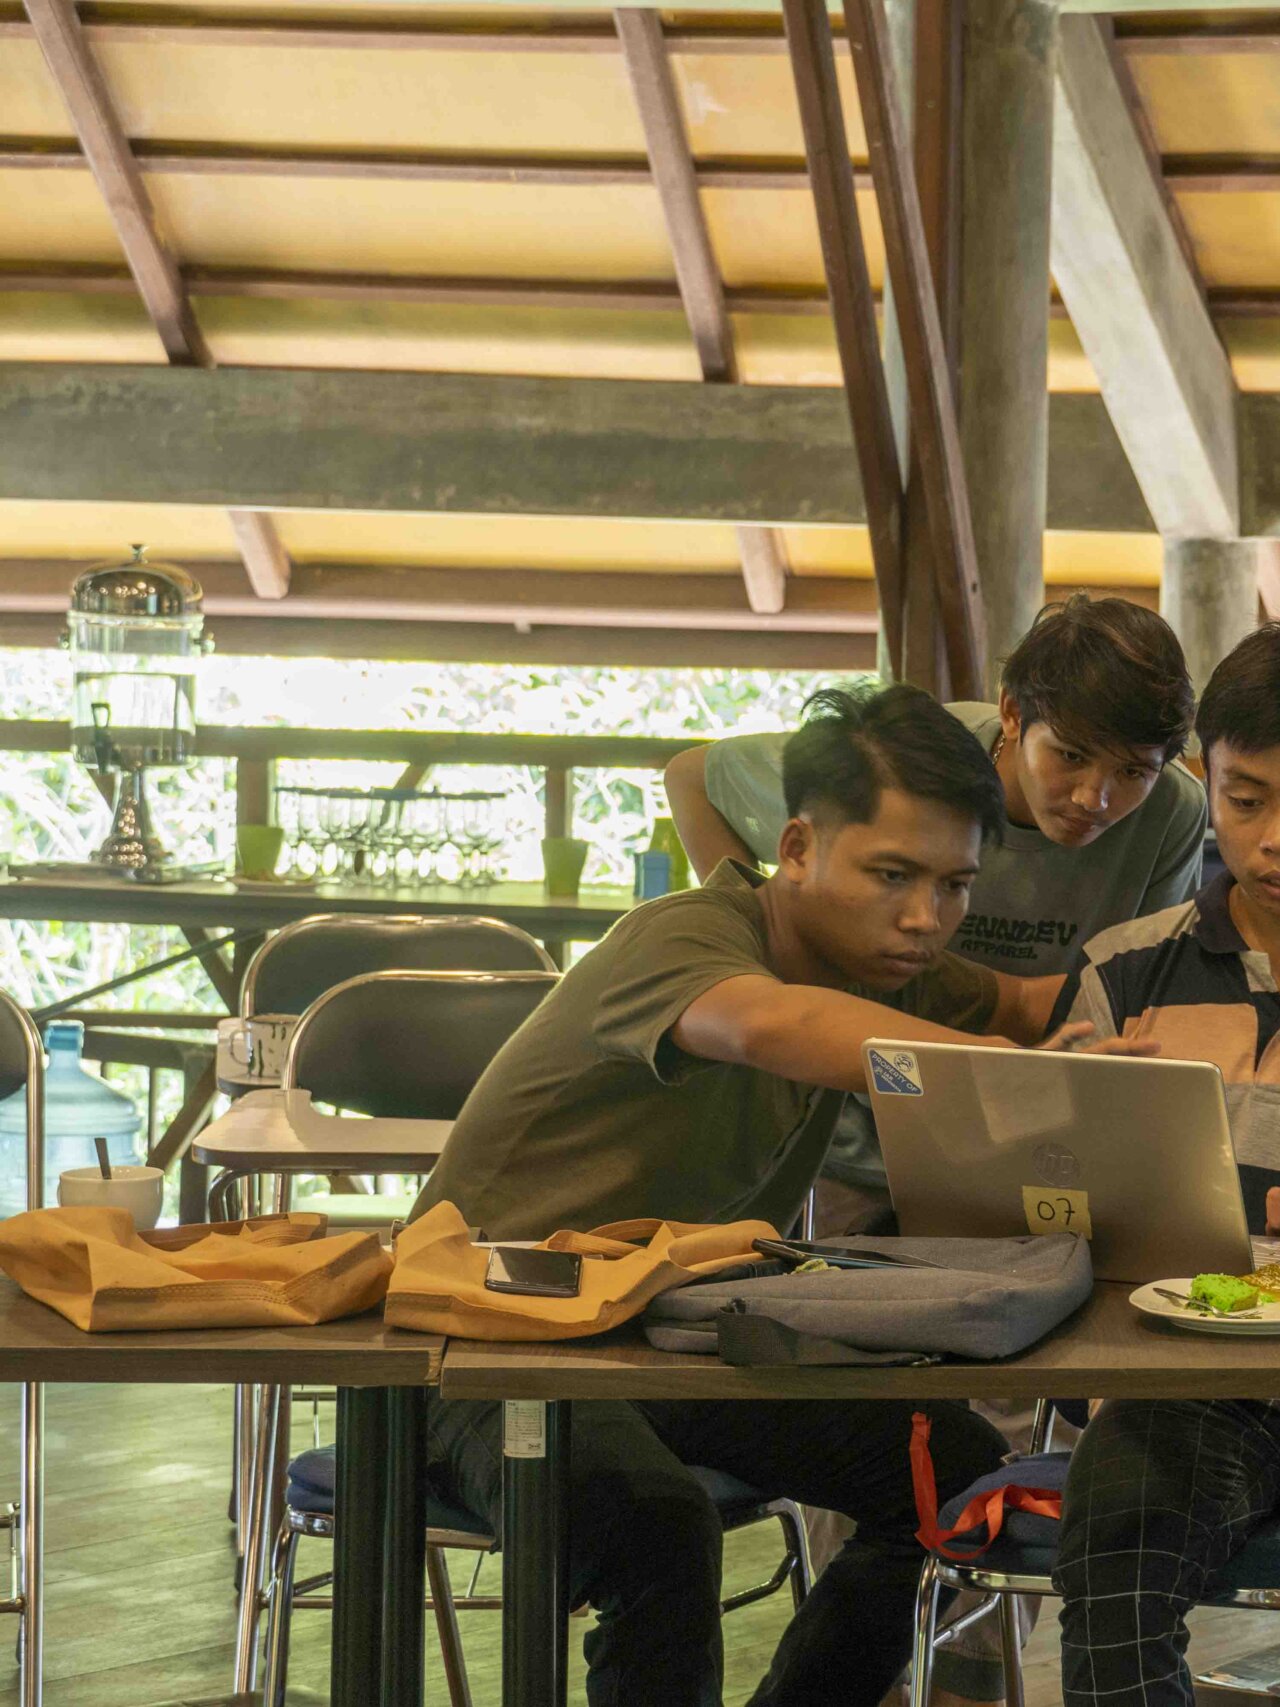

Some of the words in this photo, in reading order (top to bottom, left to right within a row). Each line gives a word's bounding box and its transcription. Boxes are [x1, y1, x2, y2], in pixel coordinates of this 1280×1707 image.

[871, 1053, 906, 1083] PROPERTY
[906, 1082, 919, 1092] OF
[1037, 1198, 1076, 1225] 07
